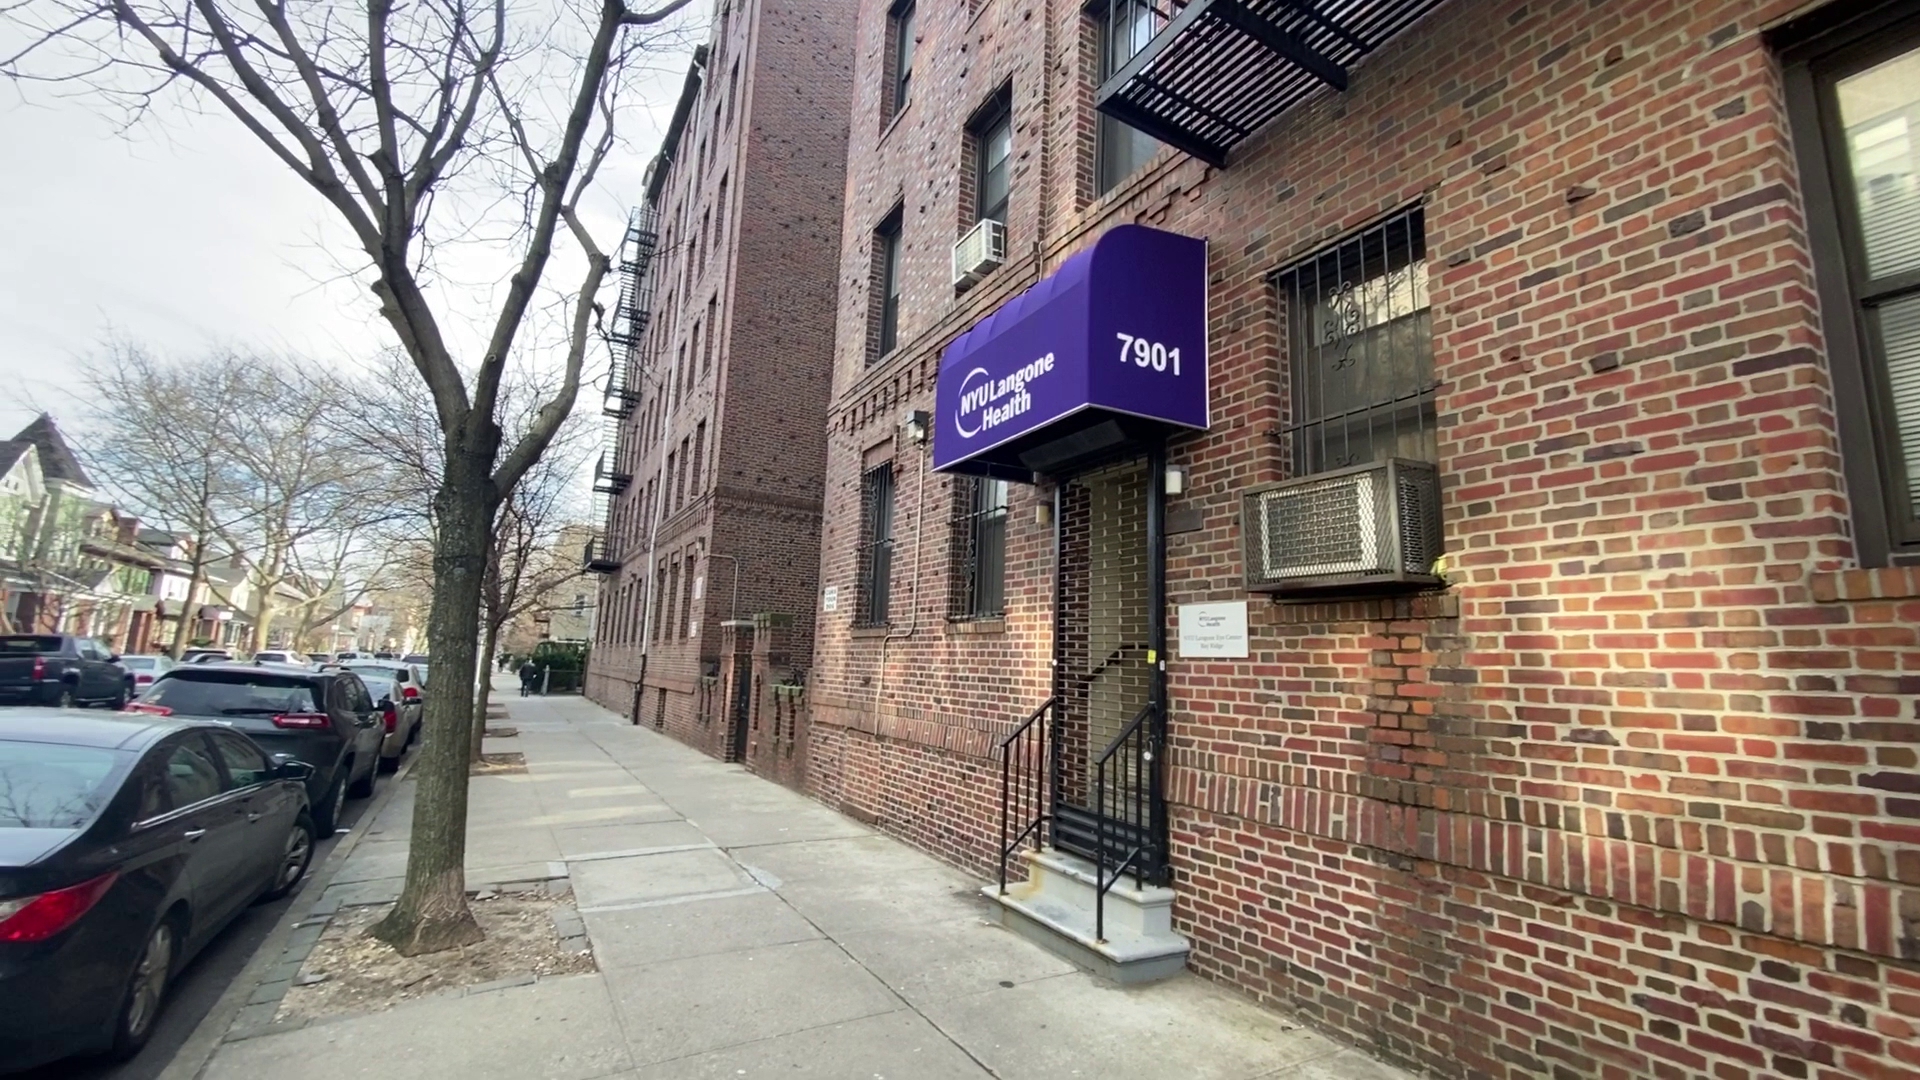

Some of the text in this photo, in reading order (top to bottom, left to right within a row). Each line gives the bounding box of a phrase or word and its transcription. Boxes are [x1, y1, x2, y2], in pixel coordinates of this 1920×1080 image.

[1116, 332, 1180, 376] 7901
[960, 352, 1055, 417] NYU Langone
[982, 390, 1031, 431] Health
